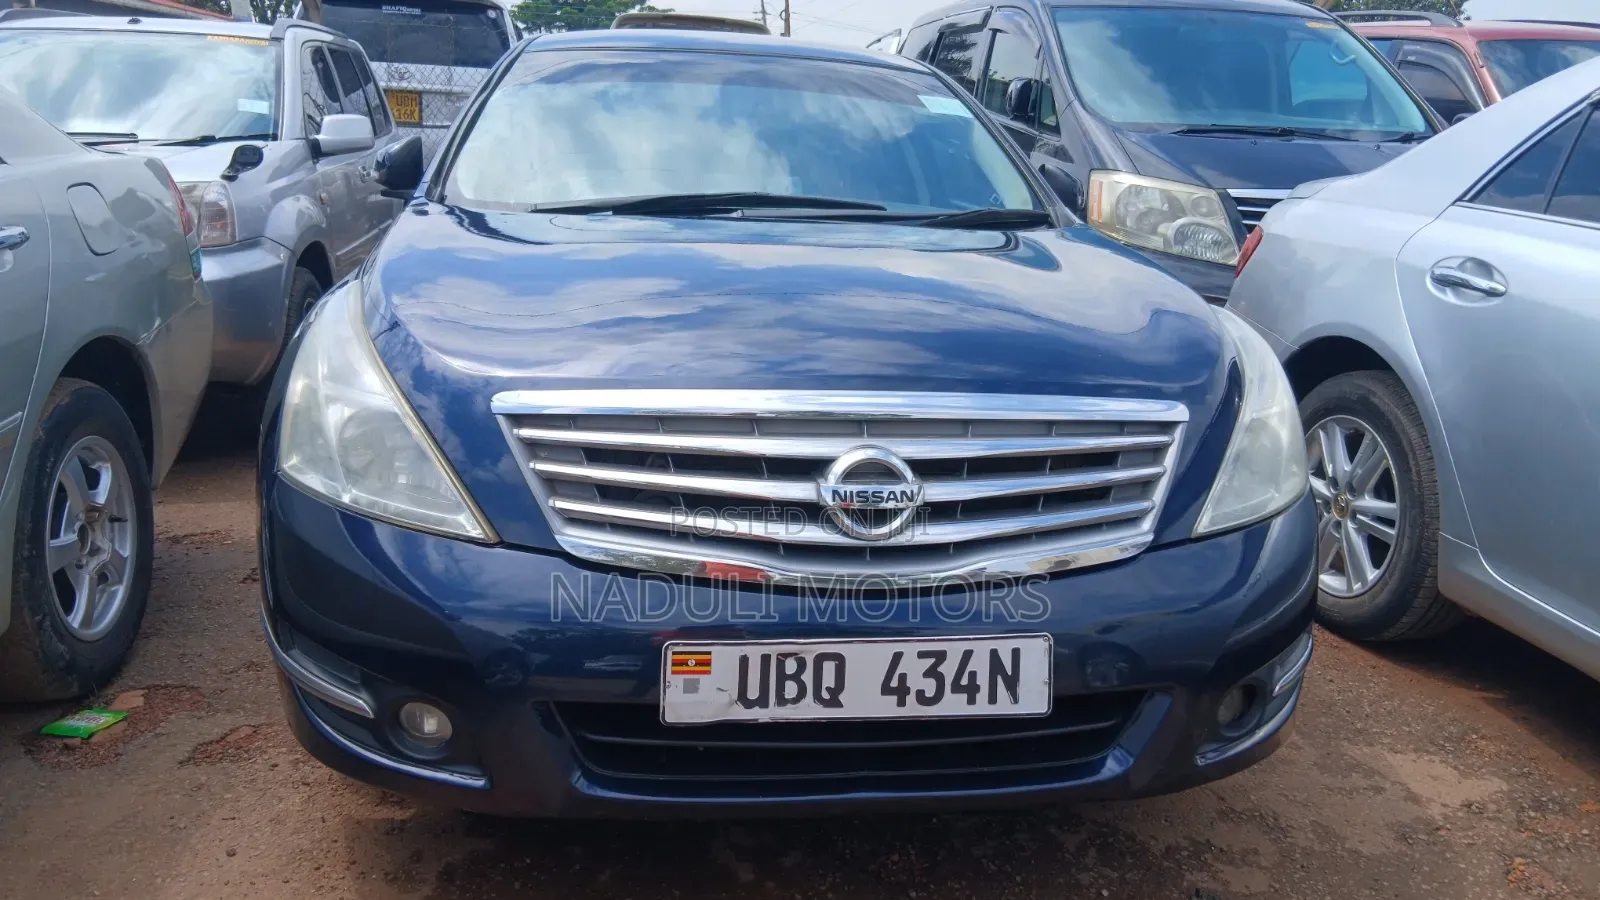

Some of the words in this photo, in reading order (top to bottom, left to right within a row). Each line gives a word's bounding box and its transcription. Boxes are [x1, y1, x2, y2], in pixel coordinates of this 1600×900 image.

[831, 489, 914, 504] NISSAN
[736, 651, 847, 709] UBQ
[880, 647, 1021, 708] 434N
